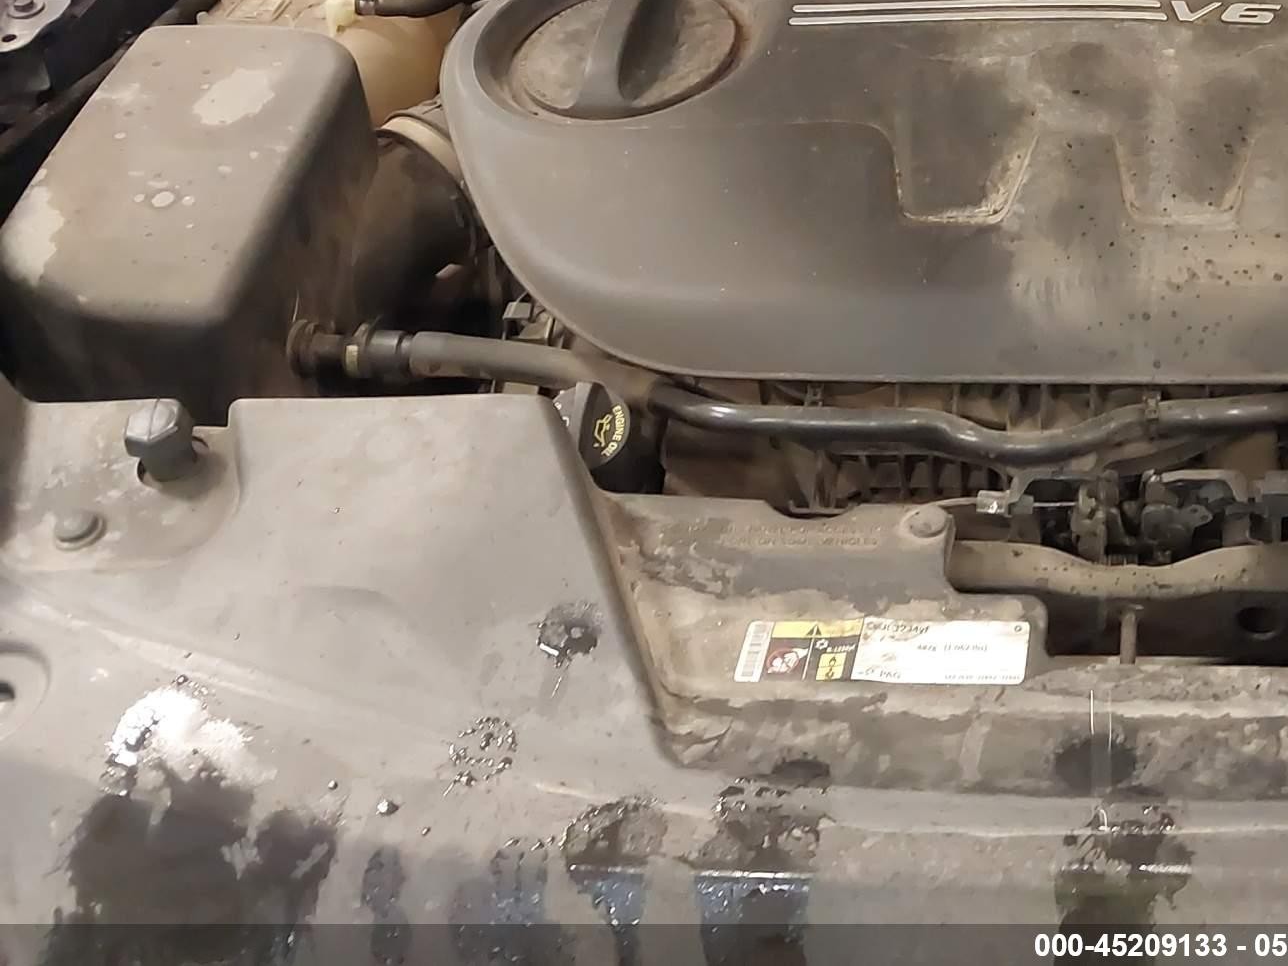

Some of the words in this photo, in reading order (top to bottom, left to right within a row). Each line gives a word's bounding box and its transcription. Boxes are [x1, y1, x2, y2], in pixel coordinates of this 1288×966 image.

[1171, 0, 1282, 25] V6
[612, 405, 625, 442] ENGINE
[601, 441, 618, 456] OIL
